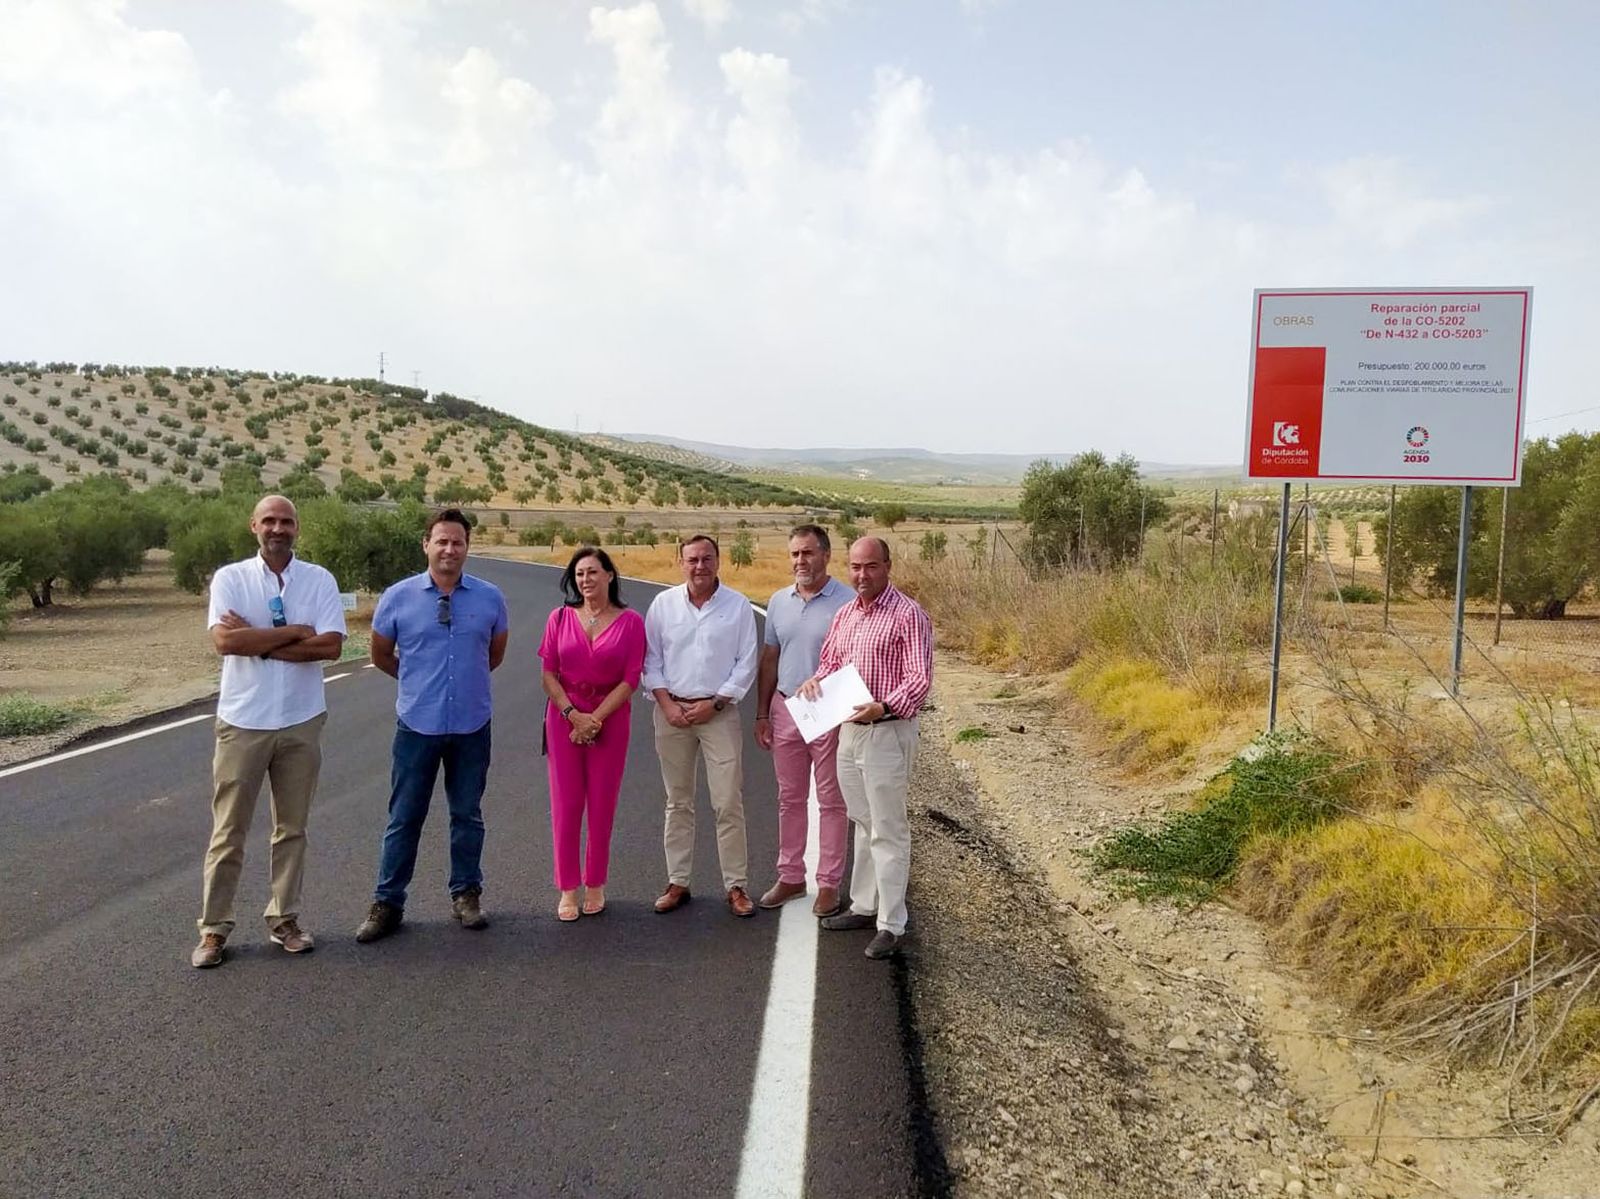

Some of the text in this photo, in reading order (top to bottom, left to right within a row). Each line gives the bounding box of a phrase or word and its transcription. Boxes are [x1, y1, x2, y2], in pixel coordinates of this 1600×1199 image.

[1371, 303, 1481, 314] Reparación parcial
[1273, 315, 1314, 326] OBRAS
[1384, 316, 1466, 326] de la CO-5202
[1385, 329, 1418, 339] N-432
[1422, 331, 1429, 339] a
[1358, 362, 1413, 372] Presupuesto:
[1414, 362, 1461, 371] 200.000,00
[1262, 447, 1309, 457] Diputación
[1274, 456, 1309, 464] Córdoba
[1403, 455, 1430, 463] 2030
